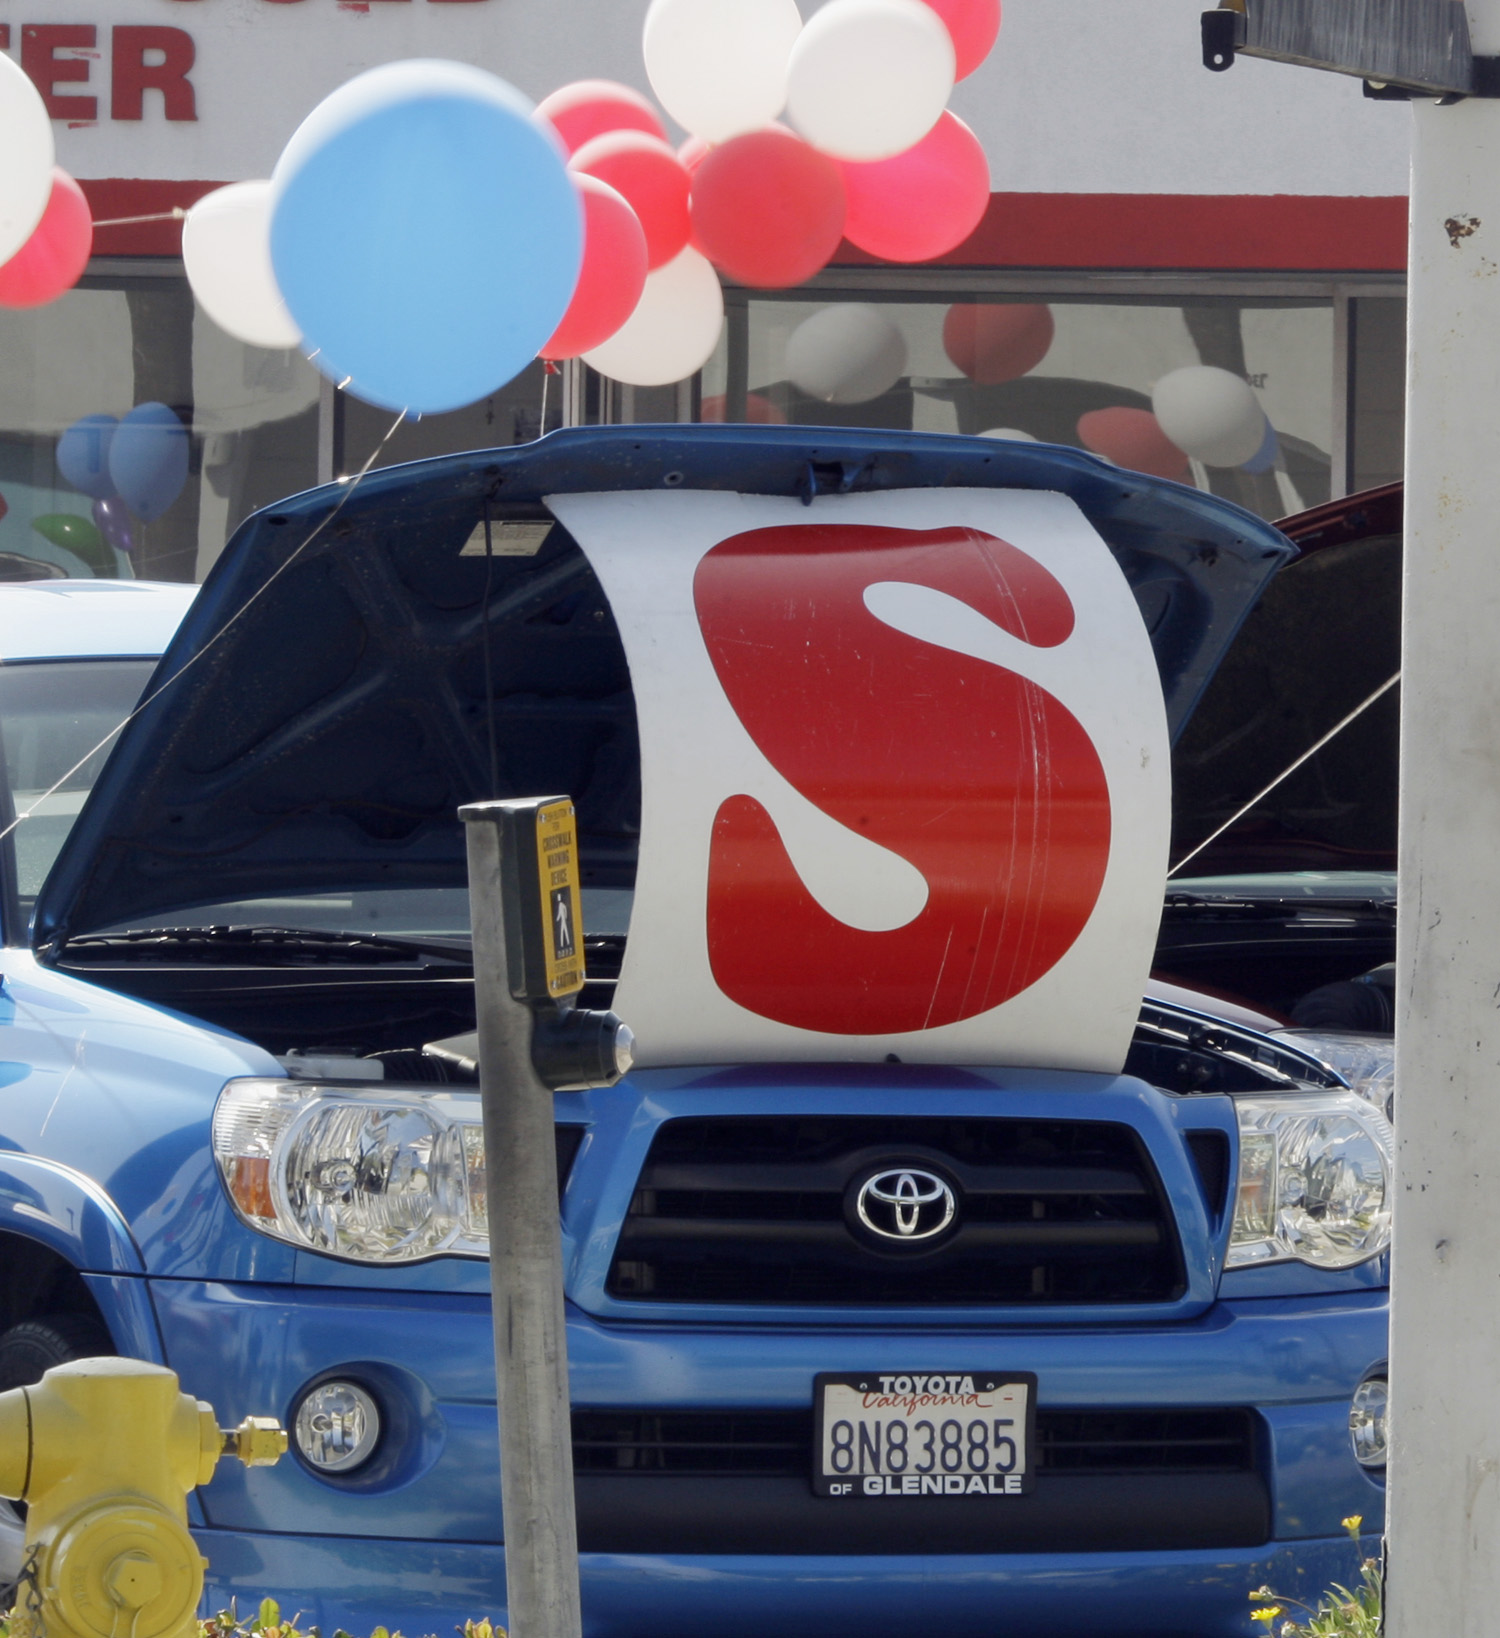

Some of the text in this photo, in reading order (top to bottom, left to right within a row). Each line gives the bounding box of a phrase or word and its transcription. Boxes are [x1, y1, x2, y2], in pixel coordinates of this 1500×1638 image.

[879, 1376, 976, 1395] TOYOTA
[861, 1391, 993, 1417] California
[831, 1419, 1016, 1474] 8N83885
[829, 1475, 1023, 1496] OF GLENDALE
